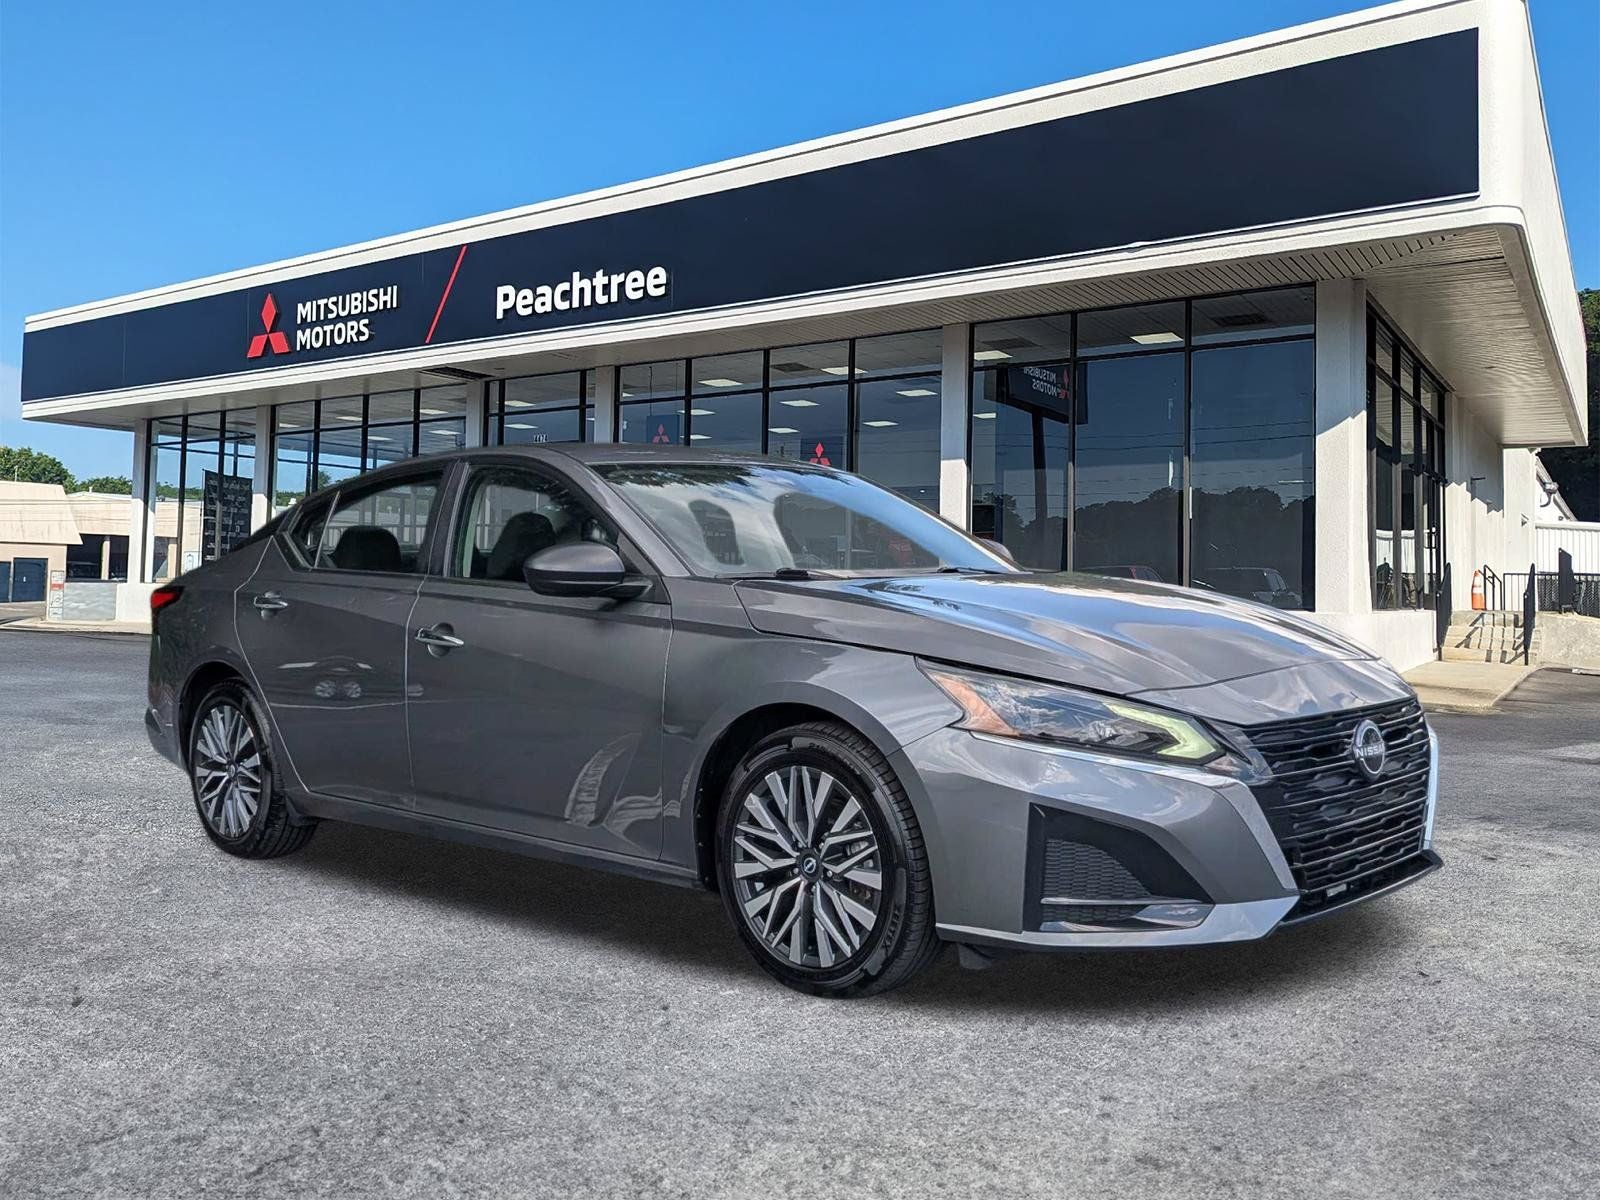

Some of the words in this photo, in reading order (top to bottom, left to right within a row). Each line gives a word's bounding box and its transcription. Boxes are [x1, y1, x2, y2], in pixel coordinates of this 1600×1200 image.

[296, 285, 397, 324] MITSUBISHI
[496, 266, 667, 320] Peachtree
[296, 318, 369, 350] MOTORS
